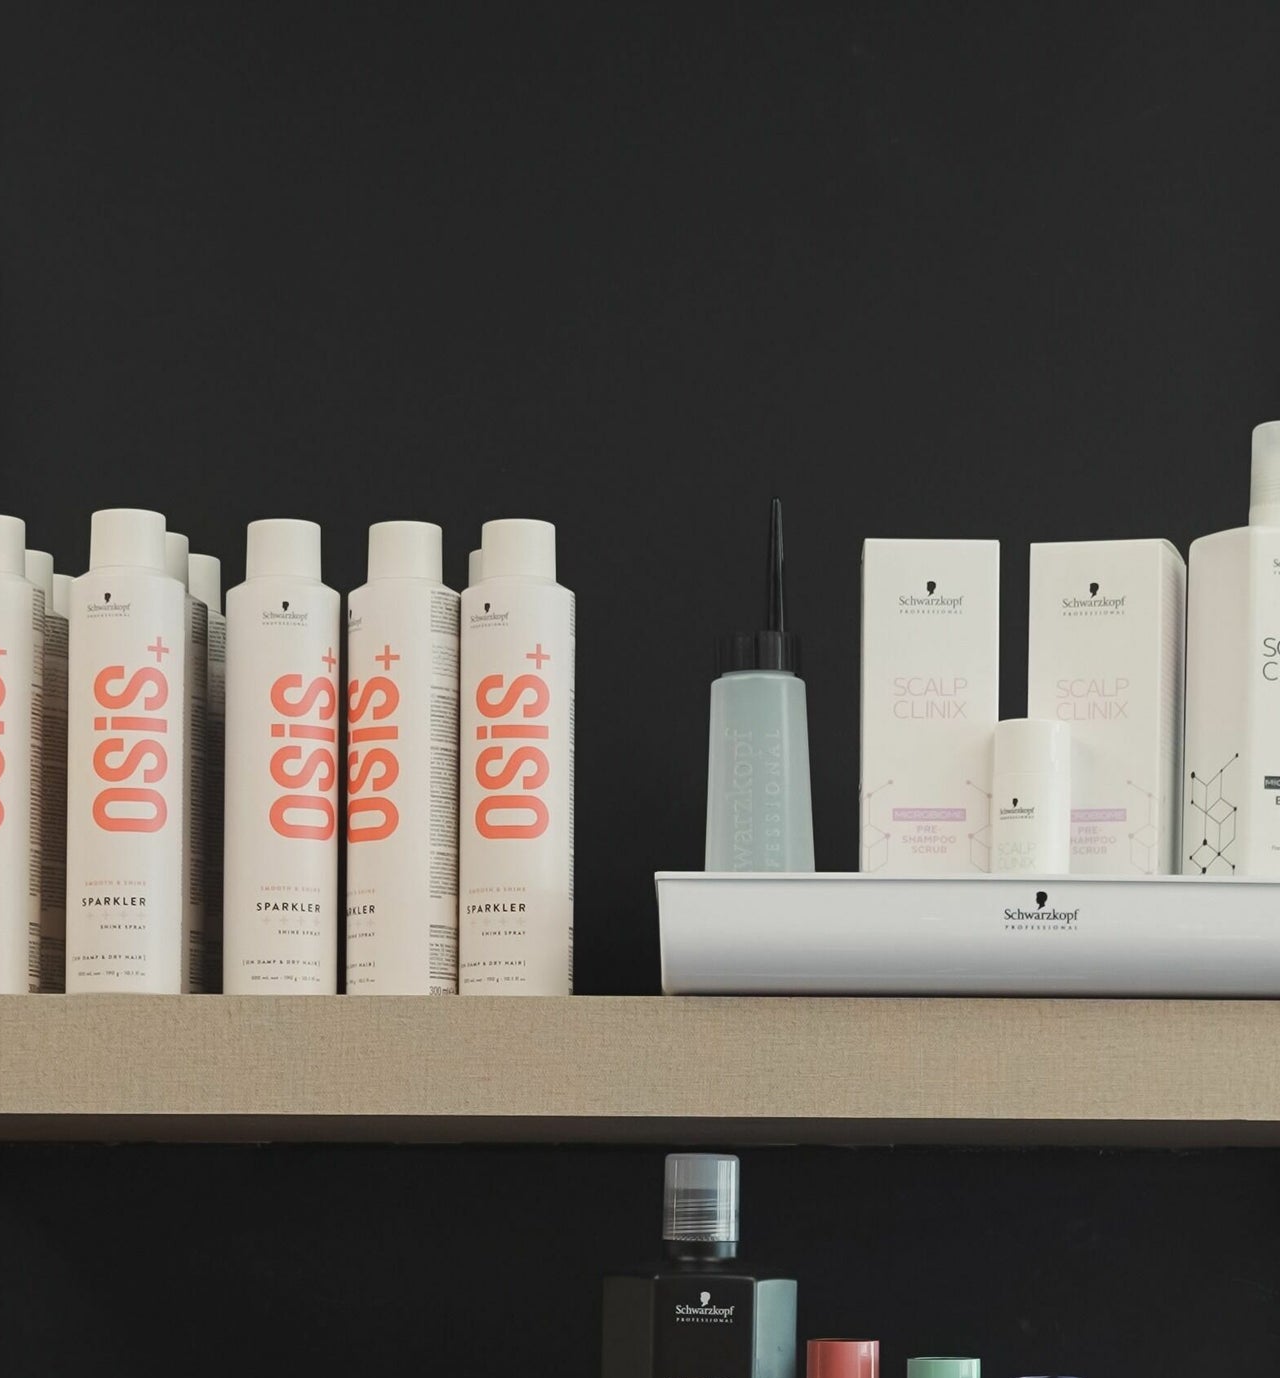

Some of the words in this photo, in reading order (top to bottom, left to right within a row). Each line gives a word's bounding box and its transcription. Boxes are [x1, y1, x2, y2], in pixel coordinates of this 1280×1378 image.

[898, 595, 964, 608] Schwarzkopf
[1062, 595, 1126, 609] Schwarzkopf
[893, 678, 968, 697] SCALP
[1056, 679, 1129, 698] SCALP
[893, 700, 968, 719] CLINIX
[1056, 702, 1129, 721] CLINIX
[725, 728, 763, 872] warzkopf
[766, 729, 780, 868] FESSIONAL
[902, 835, 957, 844] SHAMPOO
[1070, 836, 1117, 845] HAMPOO
[82, 897, 146, 907] SPARKLER
[256, 902, 320, 913] SPARKLER
[466, 903, 526, 914] SPARKLER
[1004, 908, 1079, 924] Schwarzkopf
[676, 1304, 735, 1318] Schwarzkopf
